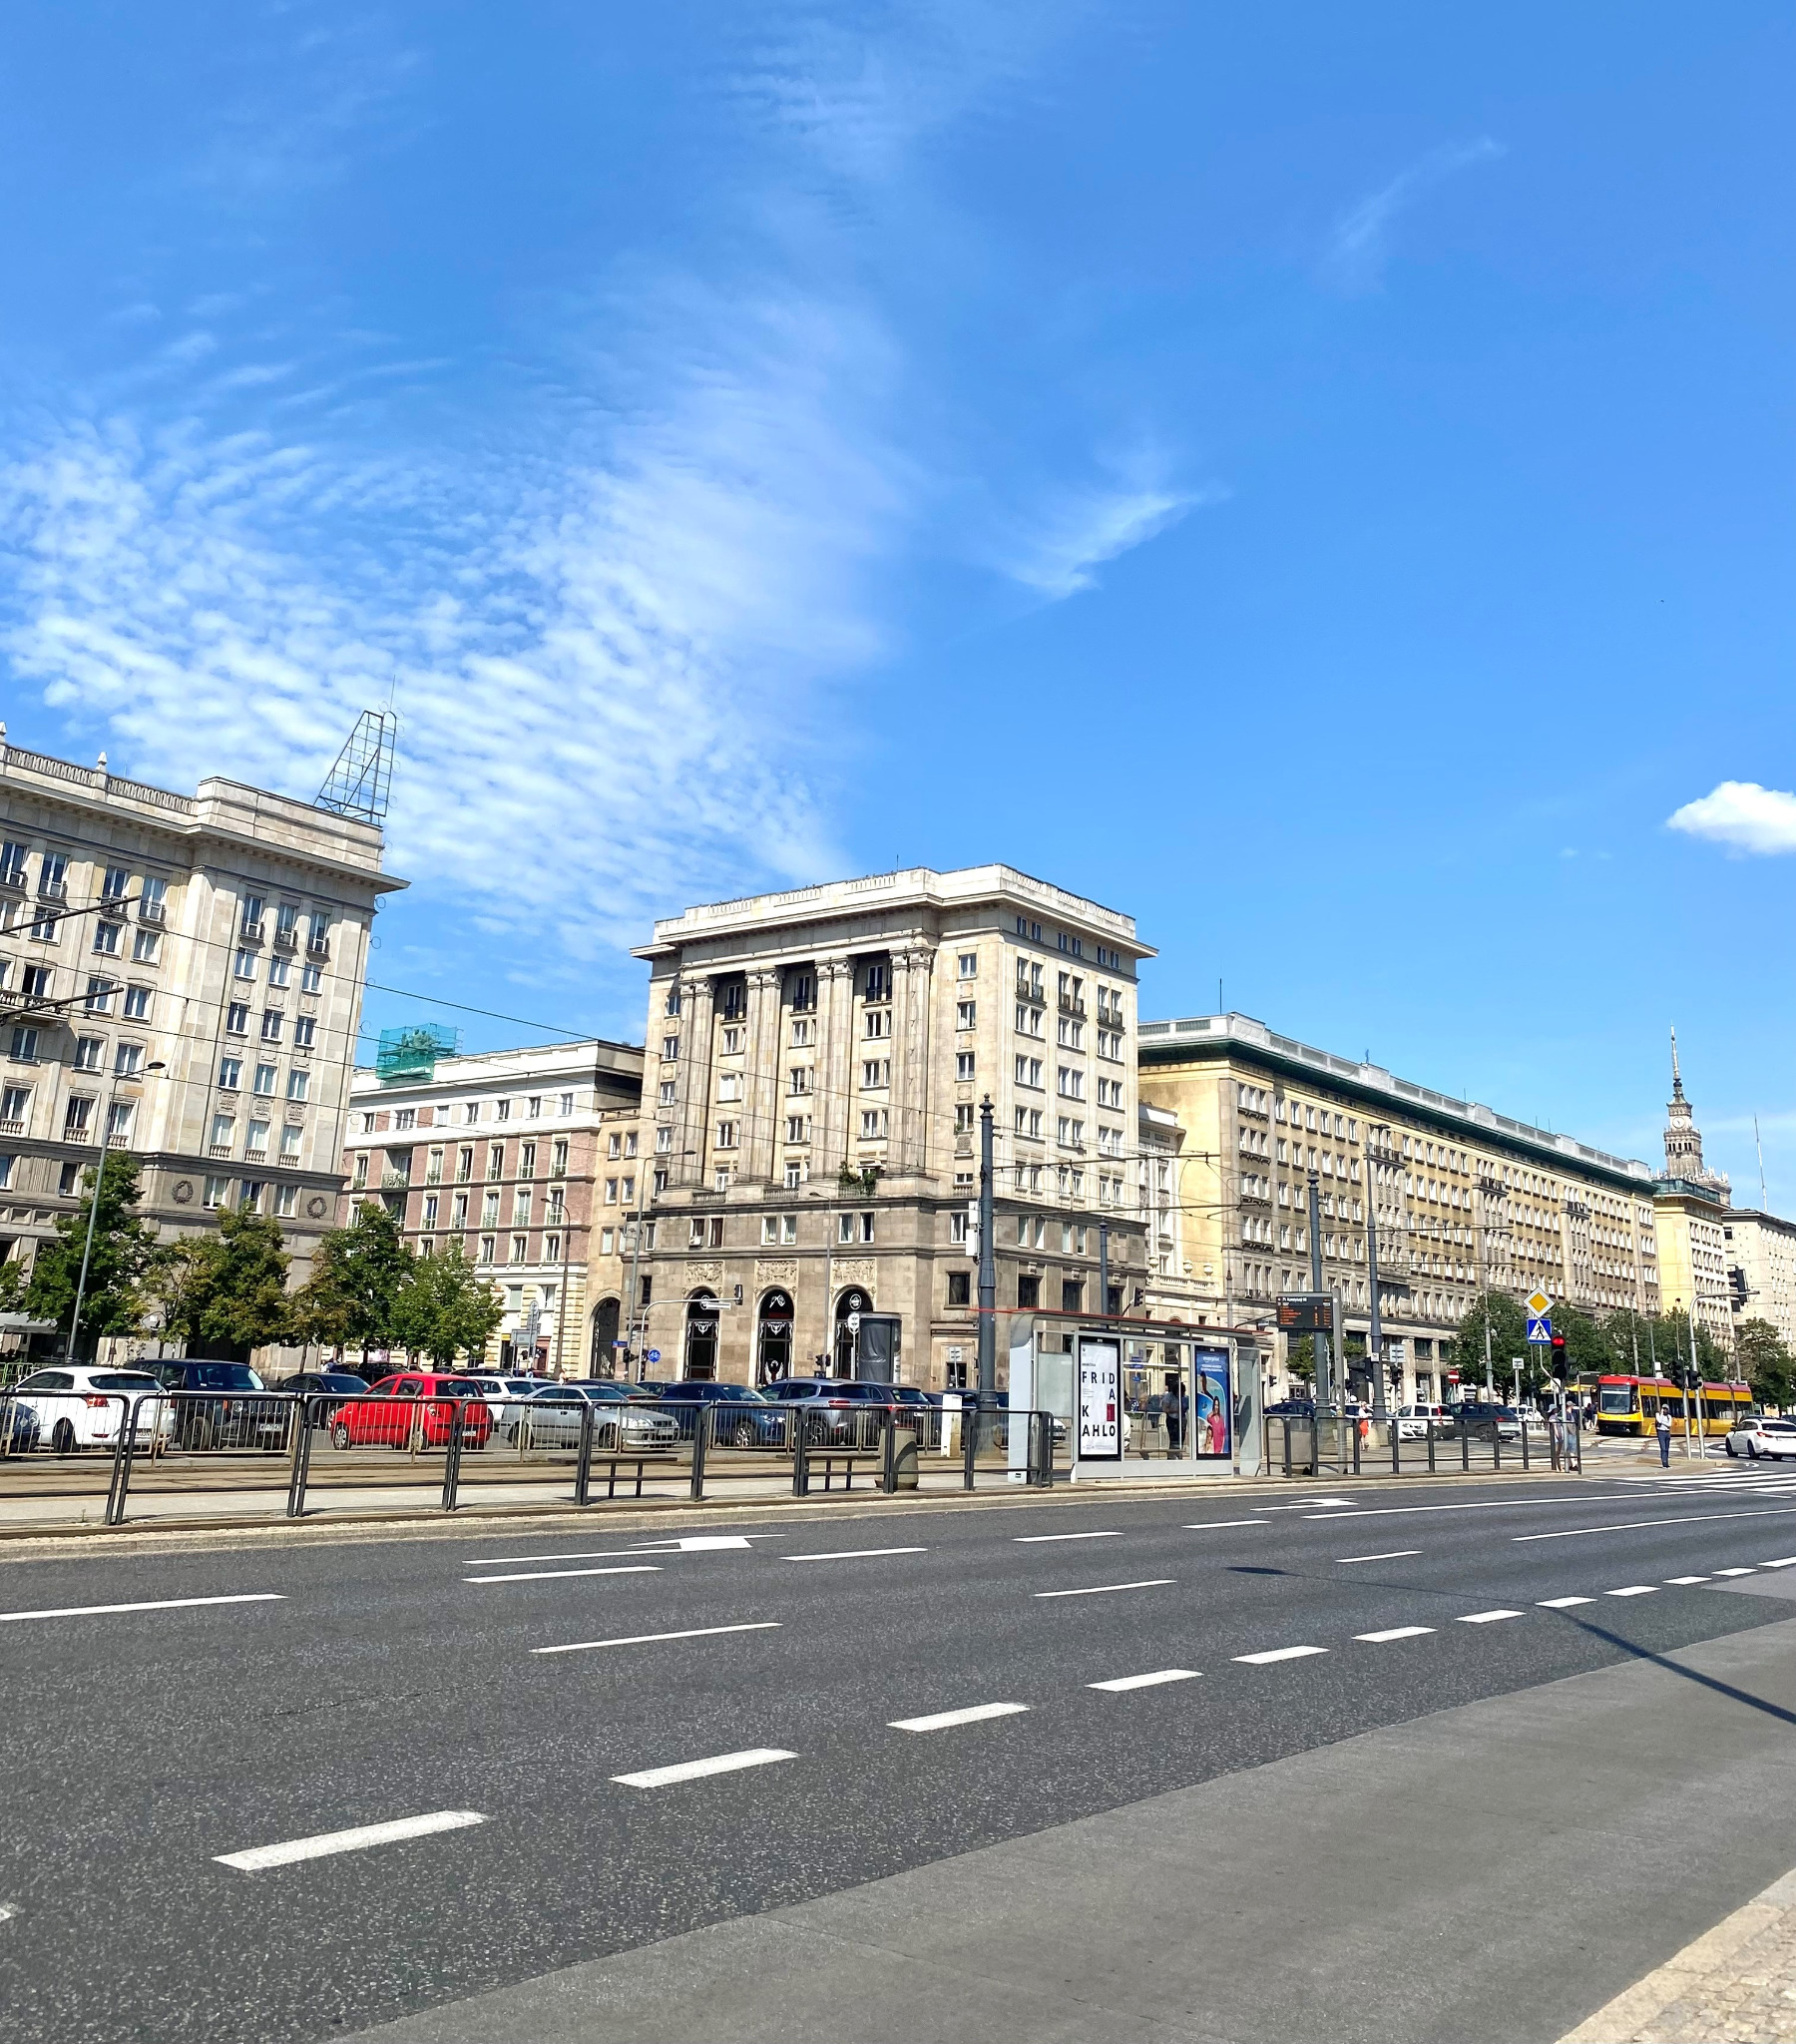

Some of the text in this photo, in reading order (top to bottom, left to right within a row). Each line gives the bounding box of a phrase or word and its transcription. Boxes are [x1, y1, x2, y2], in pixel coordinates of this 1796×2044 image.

[1109, 1388, 1116, 1400] A
[1082, 1404, 1090, 1417] K
[1082, 1424, 1116, 1437] AHLO
